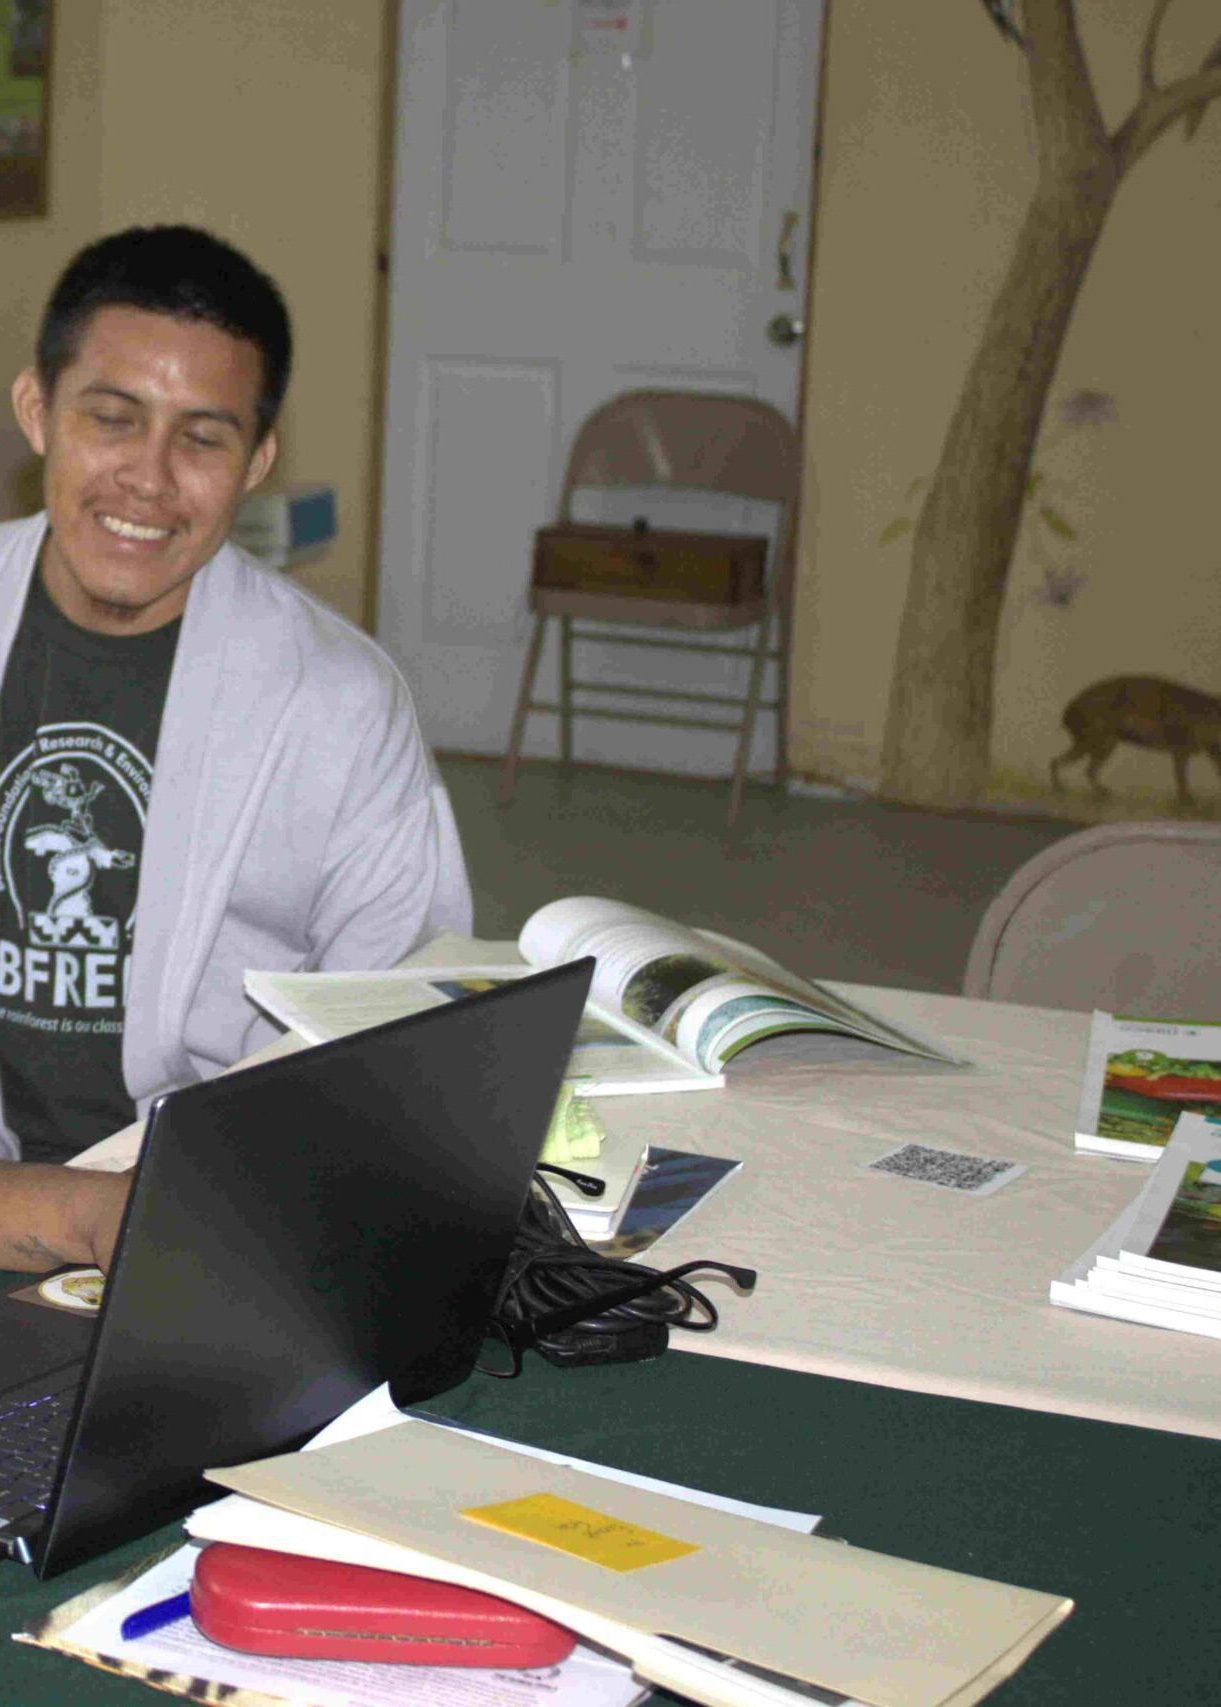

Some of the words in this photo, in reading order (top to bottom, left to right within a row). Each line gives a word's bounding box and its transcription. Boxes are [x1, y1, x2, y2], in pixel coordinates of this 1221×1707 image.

[39, 736, 104, 753] Research
[104, 744, 115, 759] &
[61, 1018, 72, 1032] is
